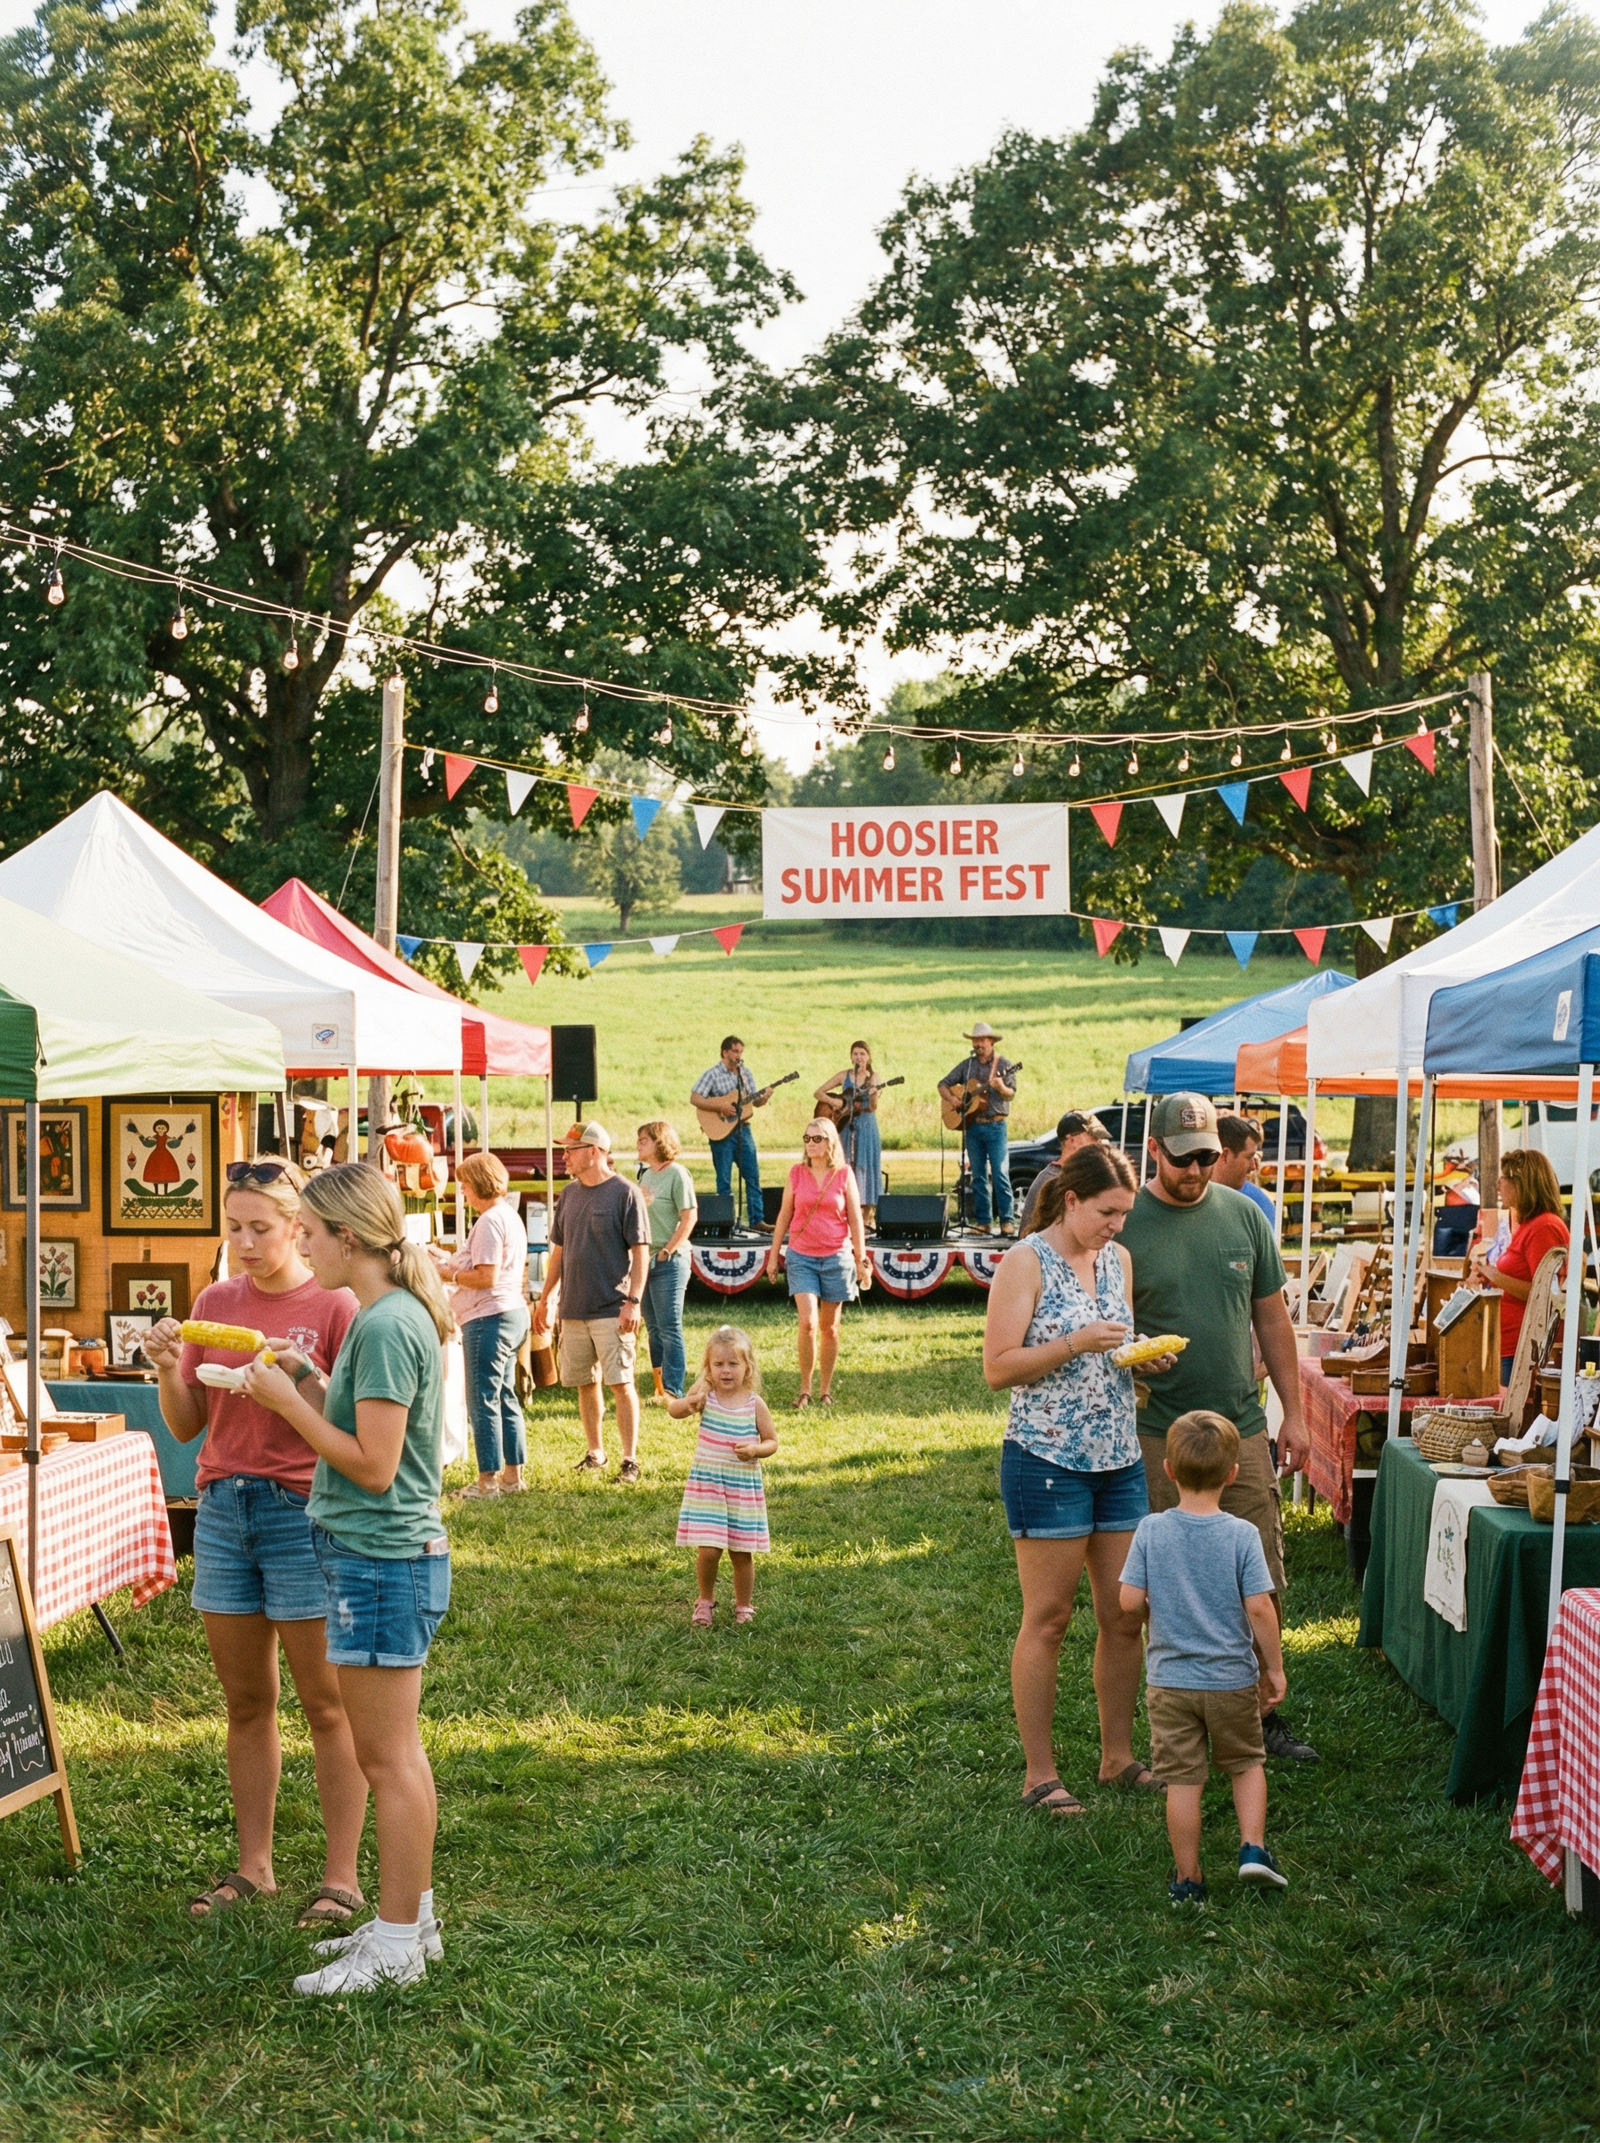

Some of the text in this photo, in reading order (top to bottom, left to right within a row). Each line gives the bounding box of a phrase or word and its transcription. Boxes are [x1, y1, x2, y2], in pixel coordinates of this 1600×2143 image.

[831, 819, 999, 857] HOOSIER
[780, 863, 1051, 904] SUMMER FEST
